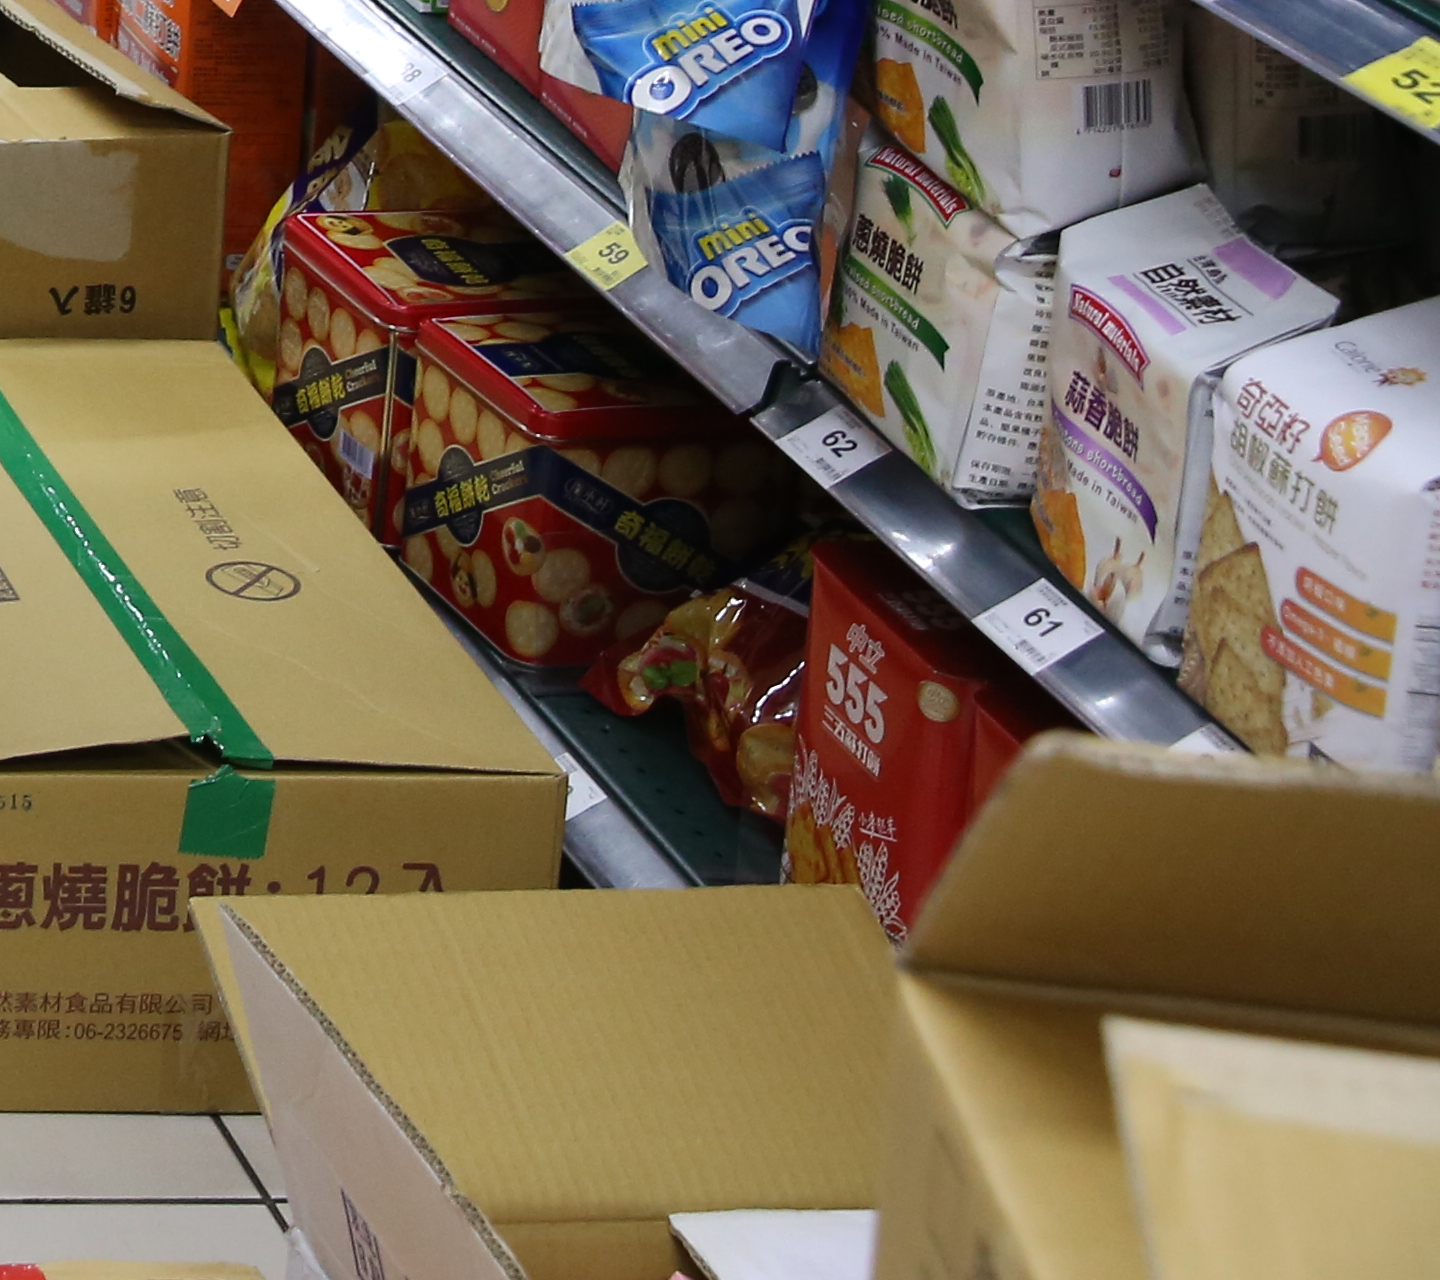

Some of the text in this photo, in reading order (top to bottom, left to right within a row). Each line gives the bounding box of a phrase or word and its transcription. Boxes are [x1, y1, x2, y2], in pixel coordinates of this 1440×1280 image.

[651, 7, 726, 63] mini
[630, 11, 782, 115] OREO
[1393, 68, 1438, 101] 52
[879, 147, 961, 217] Natural materials
[597, 243, 630, 264] 59
[698, 210, 771, 261] mini
[852, 213, 925, 296] 蔥燒脆餅
[689, 222, 815, 316] OREO
[49, 283, 137, 317] 6罐入
[1074, 292, 1146, 376] Natural materials
[294, 373, 347, 414] 奇福餅乾
[1064, 371, 1141, 464] 蒜香脆餅
[1236, 377, 1312, 454] 奇亞籽
[822, 428, 858, 459] 62
[433, 474, 491, 518] 奇福餅乾
[846, 622, 885, 675] 中立
[1022, 605, 1065, 639] 61
[825, 643, 888, 744] 555
